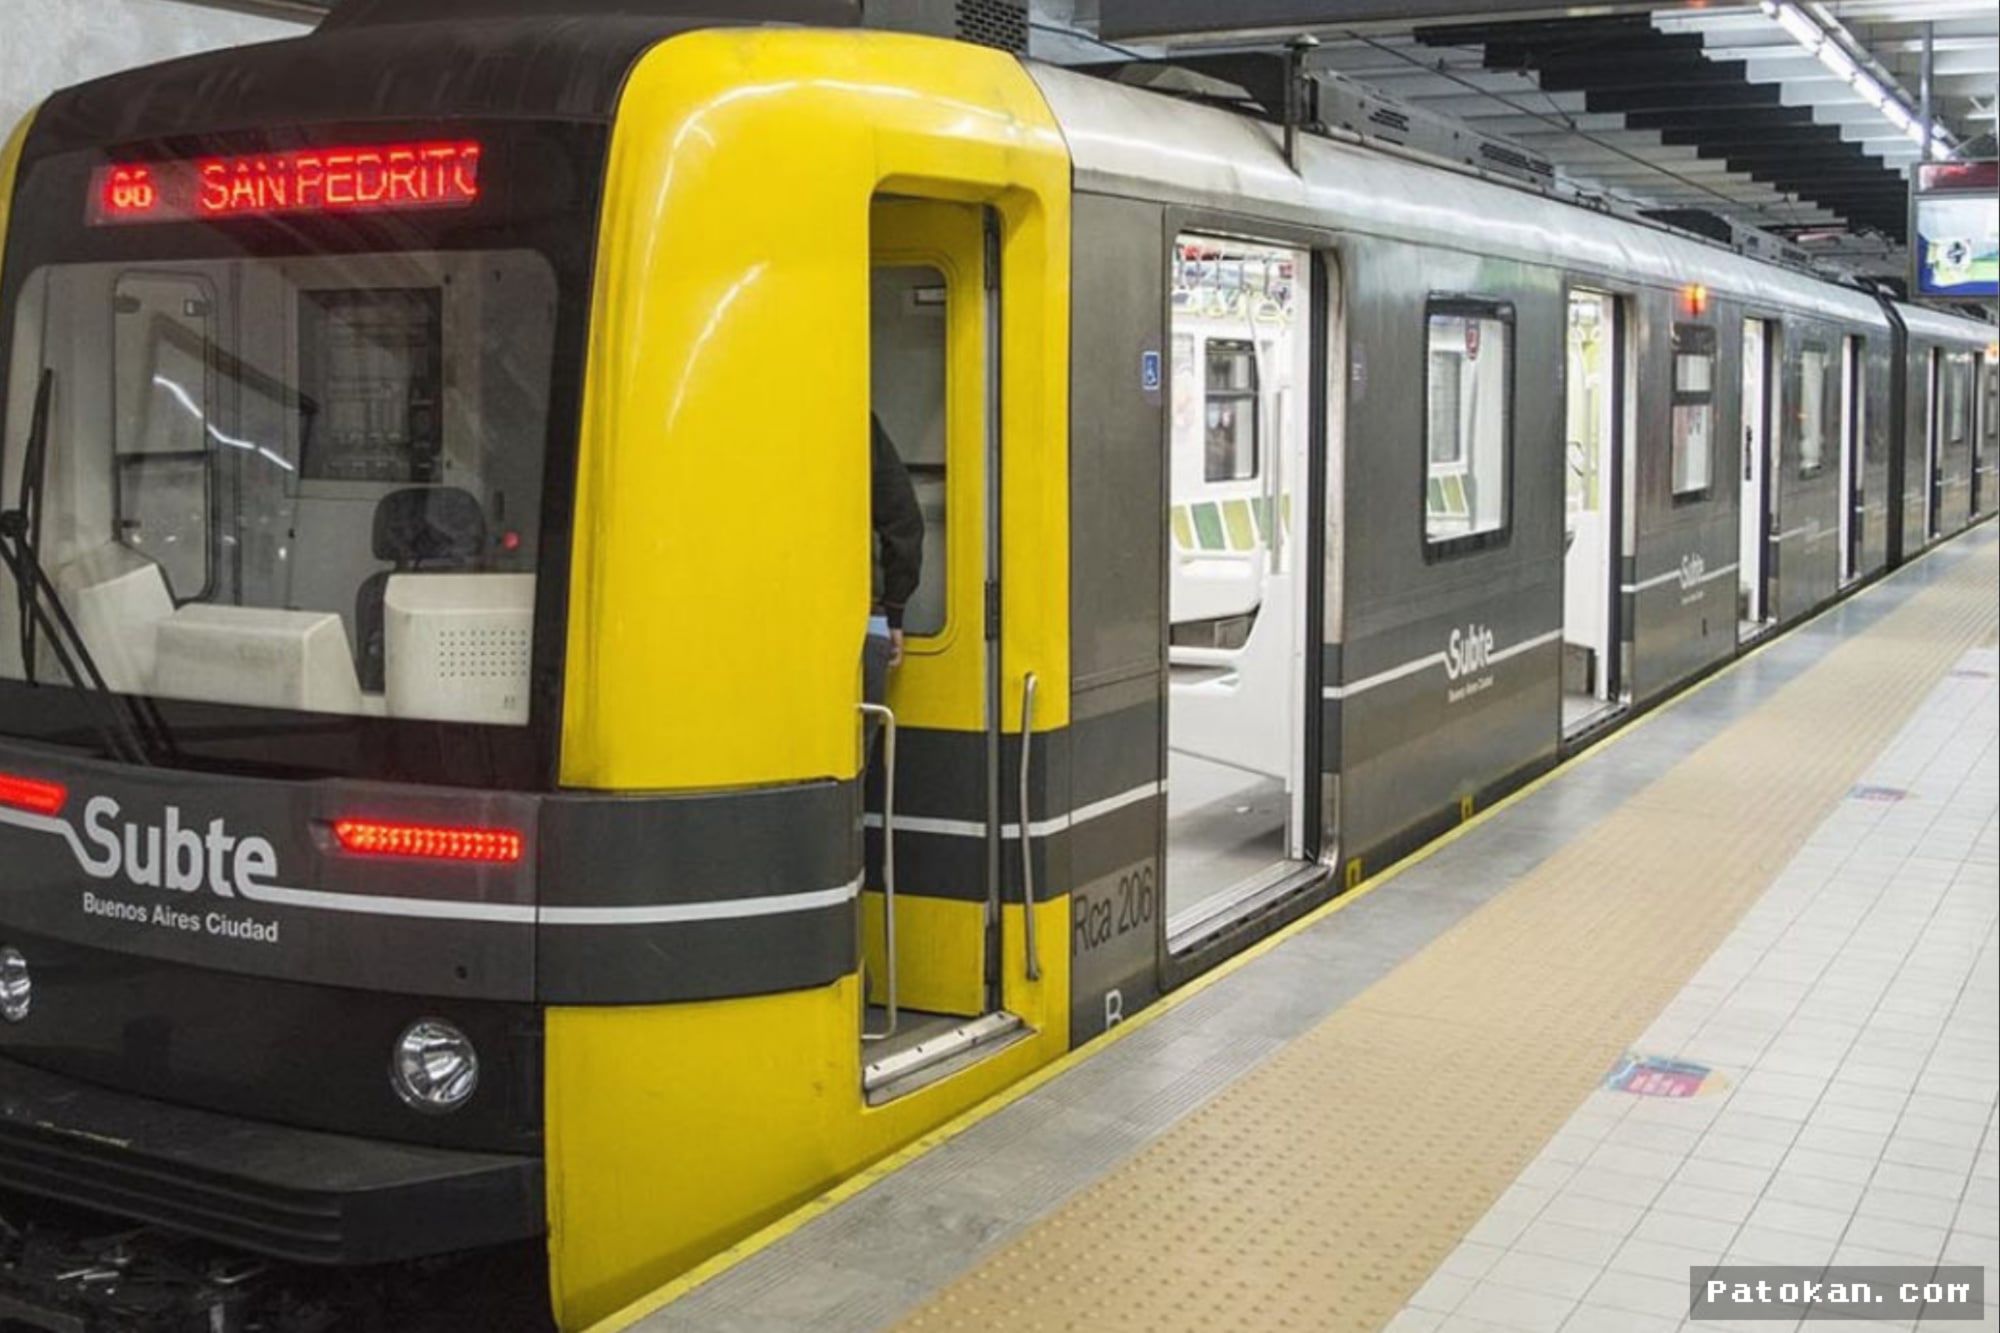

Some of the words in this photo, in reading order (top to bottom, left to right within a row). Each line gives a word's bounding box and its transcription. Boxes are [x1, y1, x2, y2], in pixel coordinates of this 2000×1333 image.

[202, 162, 286, 210] SAN
[1445, 624, 1494, 680] Subte
[83, 795, 278, 901] Subte
[83, 892, 148, 923] Buenos
[151, 904, 201, 931] Aires
[205, 912, 280, 943] Ciudad
[1073, 894, 1112, 957] Rca
[1118, 865, 1153, 936] 206
